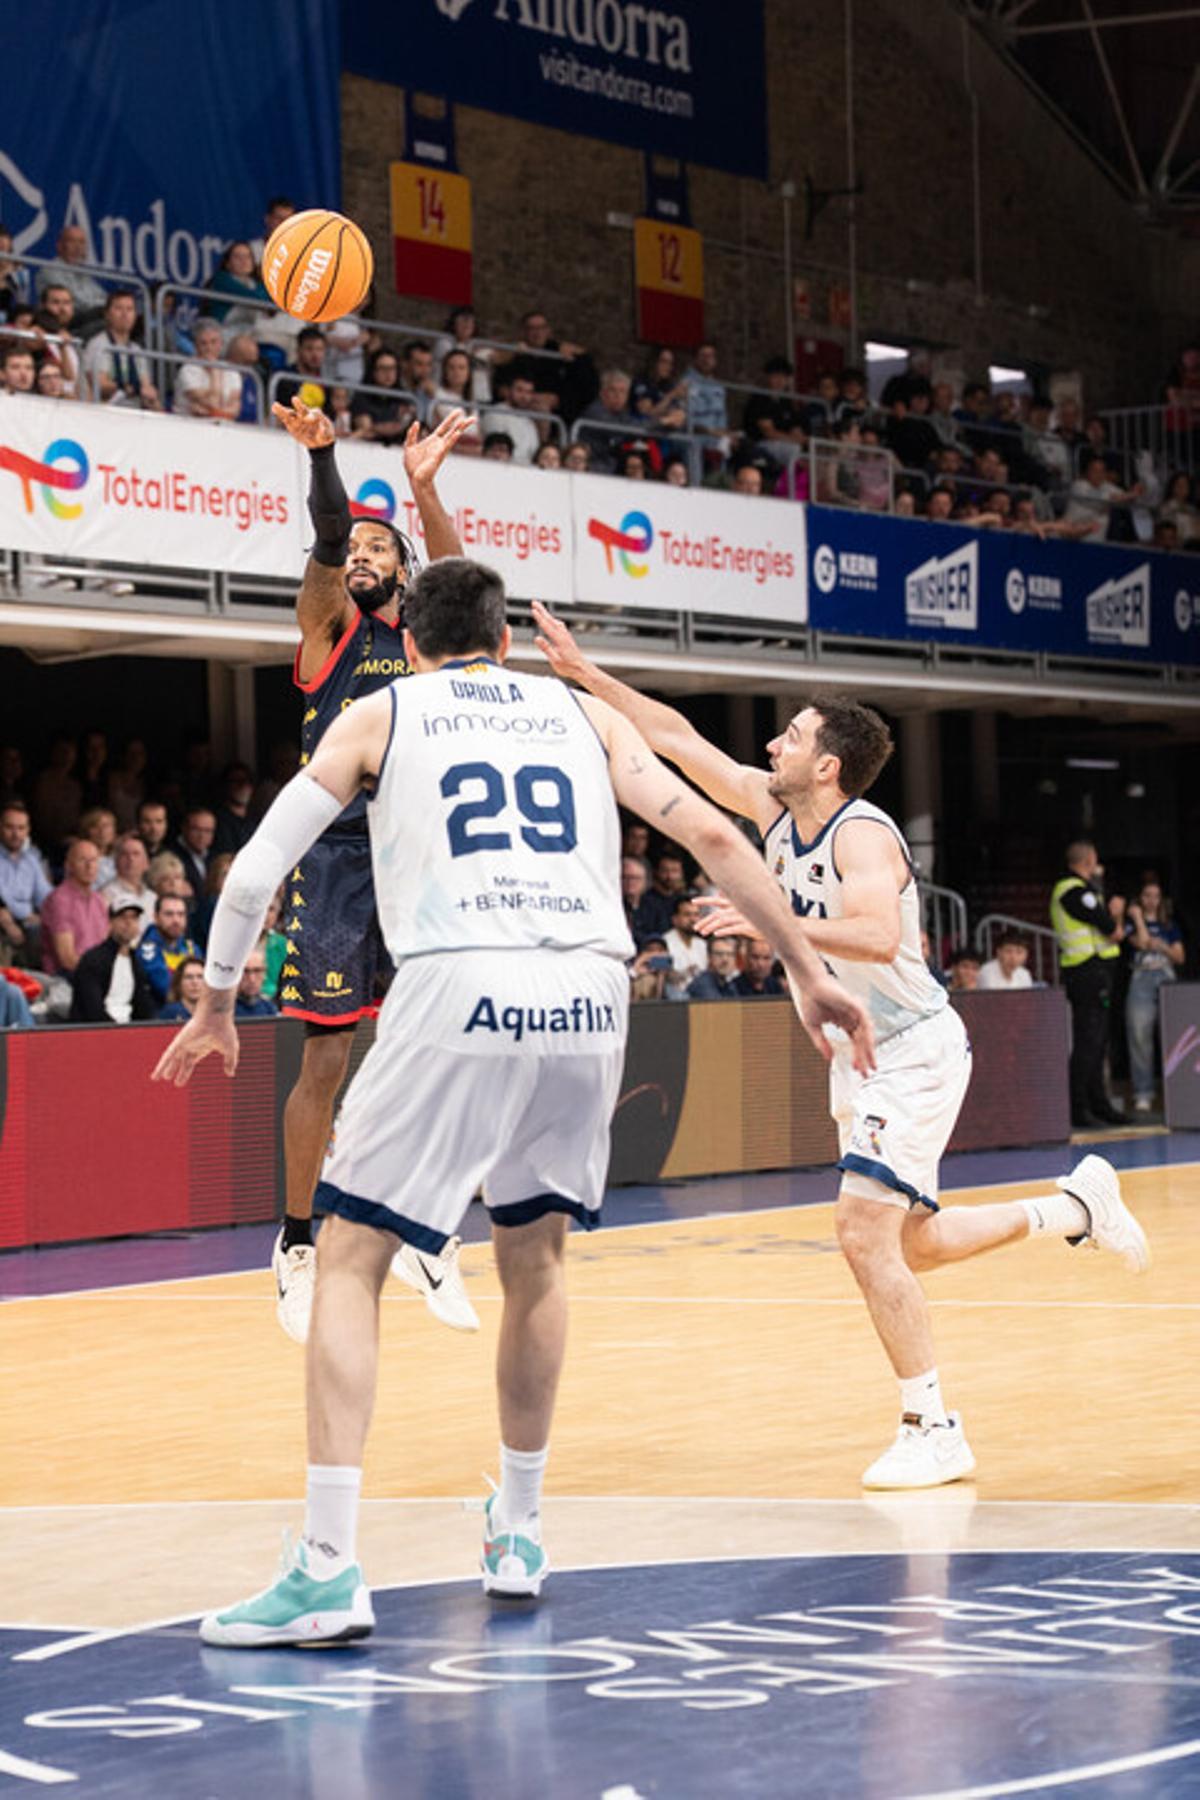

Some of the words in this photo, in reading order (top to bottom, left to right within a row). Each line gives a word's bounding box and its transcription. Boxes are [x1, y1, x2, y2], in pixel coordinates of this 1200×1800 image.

[538, 47, 693, 118] visitandorra.com
[60, 183, 234, 286] Andor
[416, 176, 445, 236] 14
[291, 248, 333, 313] Wilson
[657, 231, 682, 283] 12
[97, 464, 289, 530] TotalEnergies
[402, 501, 562, 559] TolEnergies
[659, 529, 795, 584] TotalEnergies
[838, 551, 879, 579] KERN
[908, 561, 971, 612] FINISHER
[449, 678, 525, 705] ORIOLA
[420, 712, 569, 737] inmoovs
[439, 761, 578, 859] 29
[463, 995, 616, 1042] Aquaflix
[586, 1602, 1200, 1709] LINES
